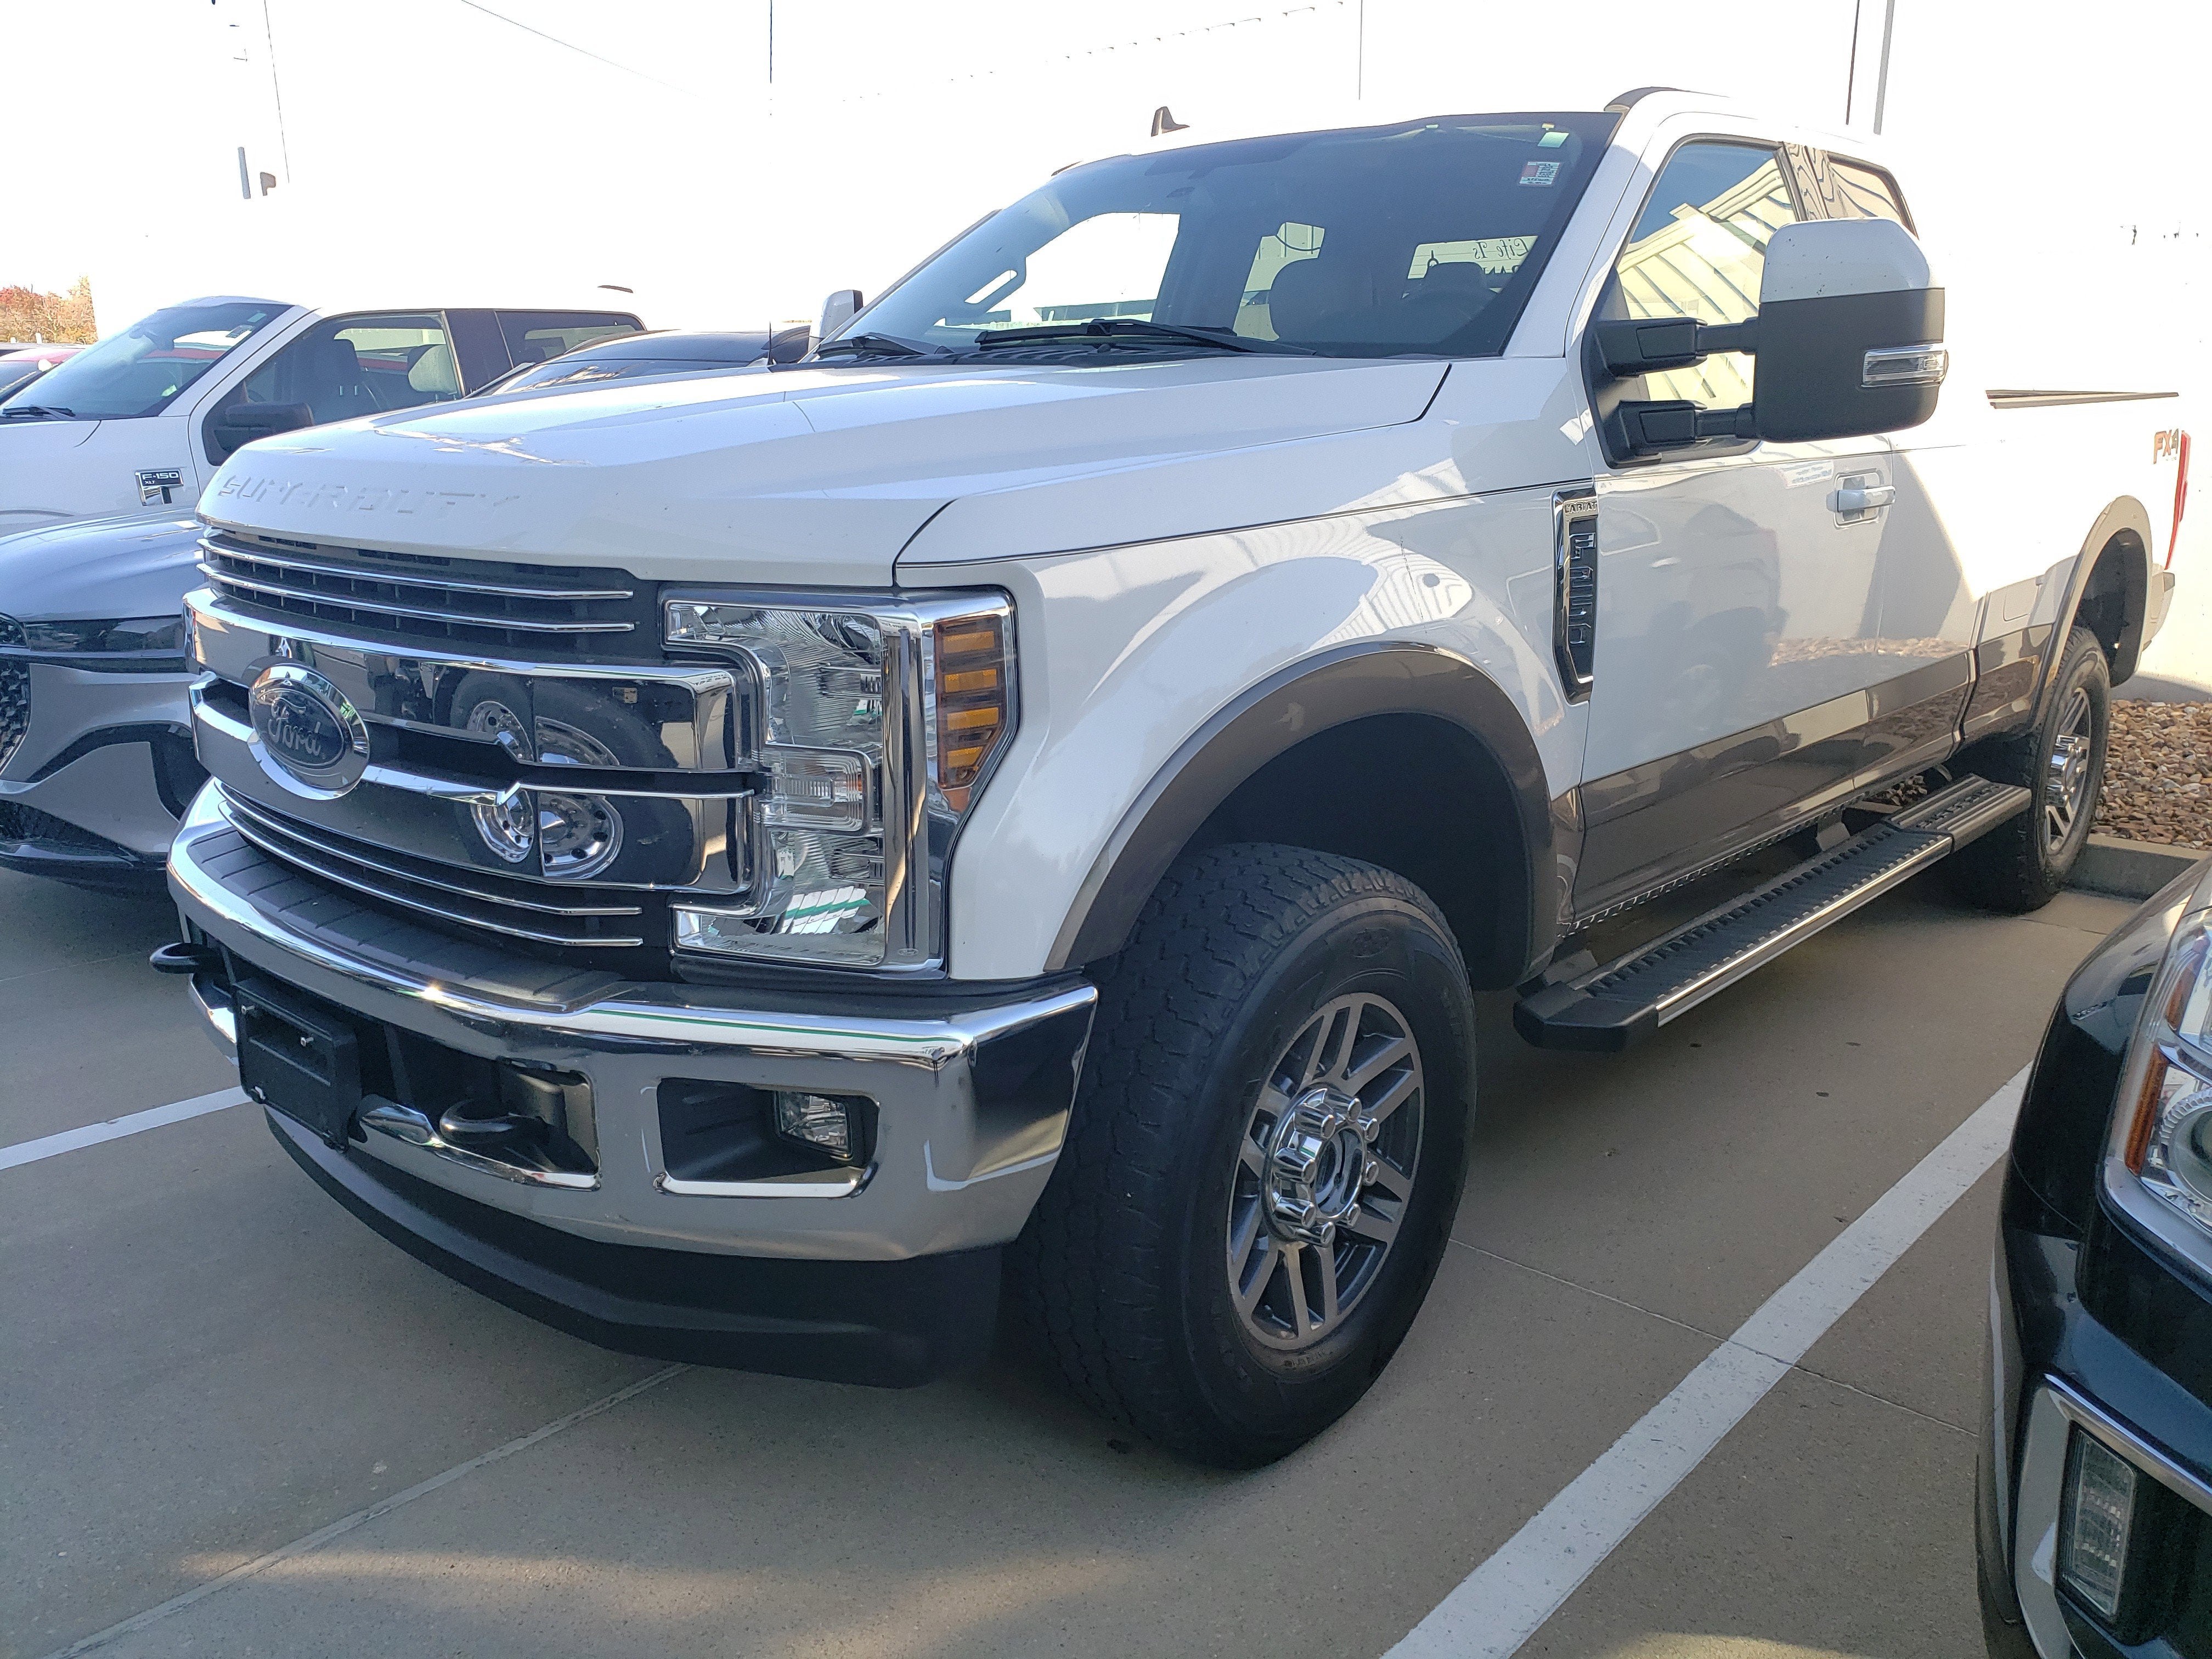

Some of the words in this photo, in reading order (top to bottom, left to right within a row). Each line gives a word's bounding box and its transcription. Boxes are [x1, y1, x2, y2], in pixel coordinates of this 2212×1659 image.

[2153, 428, 2179, 464] FX4
[217, 475, 350, 508] SUPER
[1564, 501, 1598, 514] LARIAT
[268, 697, 322, 756] Ford
